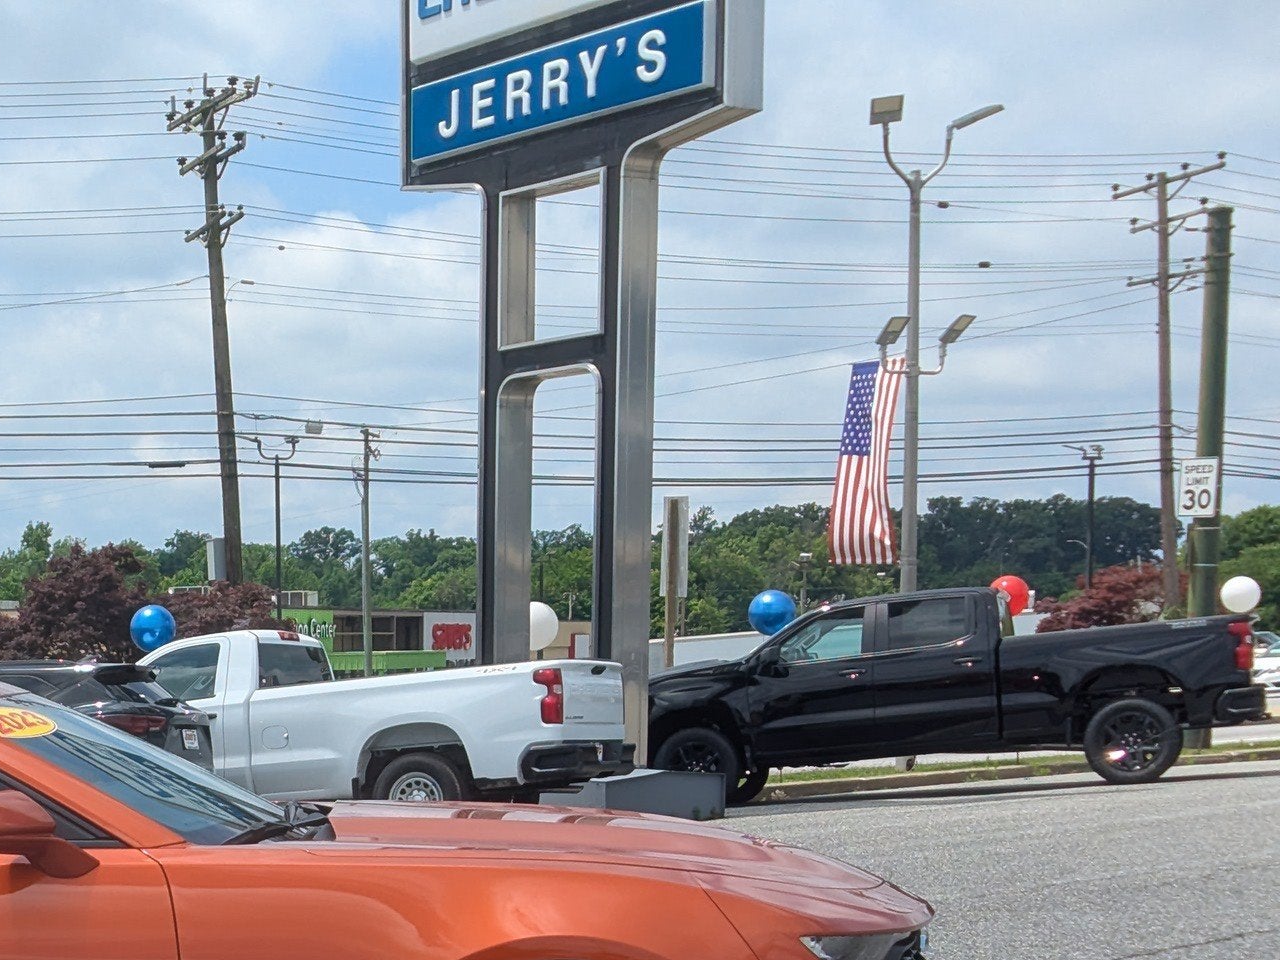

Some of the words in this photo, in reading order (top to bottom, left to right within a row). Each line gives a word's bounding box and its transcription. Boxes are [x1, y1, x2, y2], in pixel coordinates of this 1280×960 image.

[437, 28, 667, 139] JERRY'S
[1184, 464, 1214, 474] SPEED
[1186, 476, 1210, 486] LIMIT
[1182, 488, 1211, 510] 30
